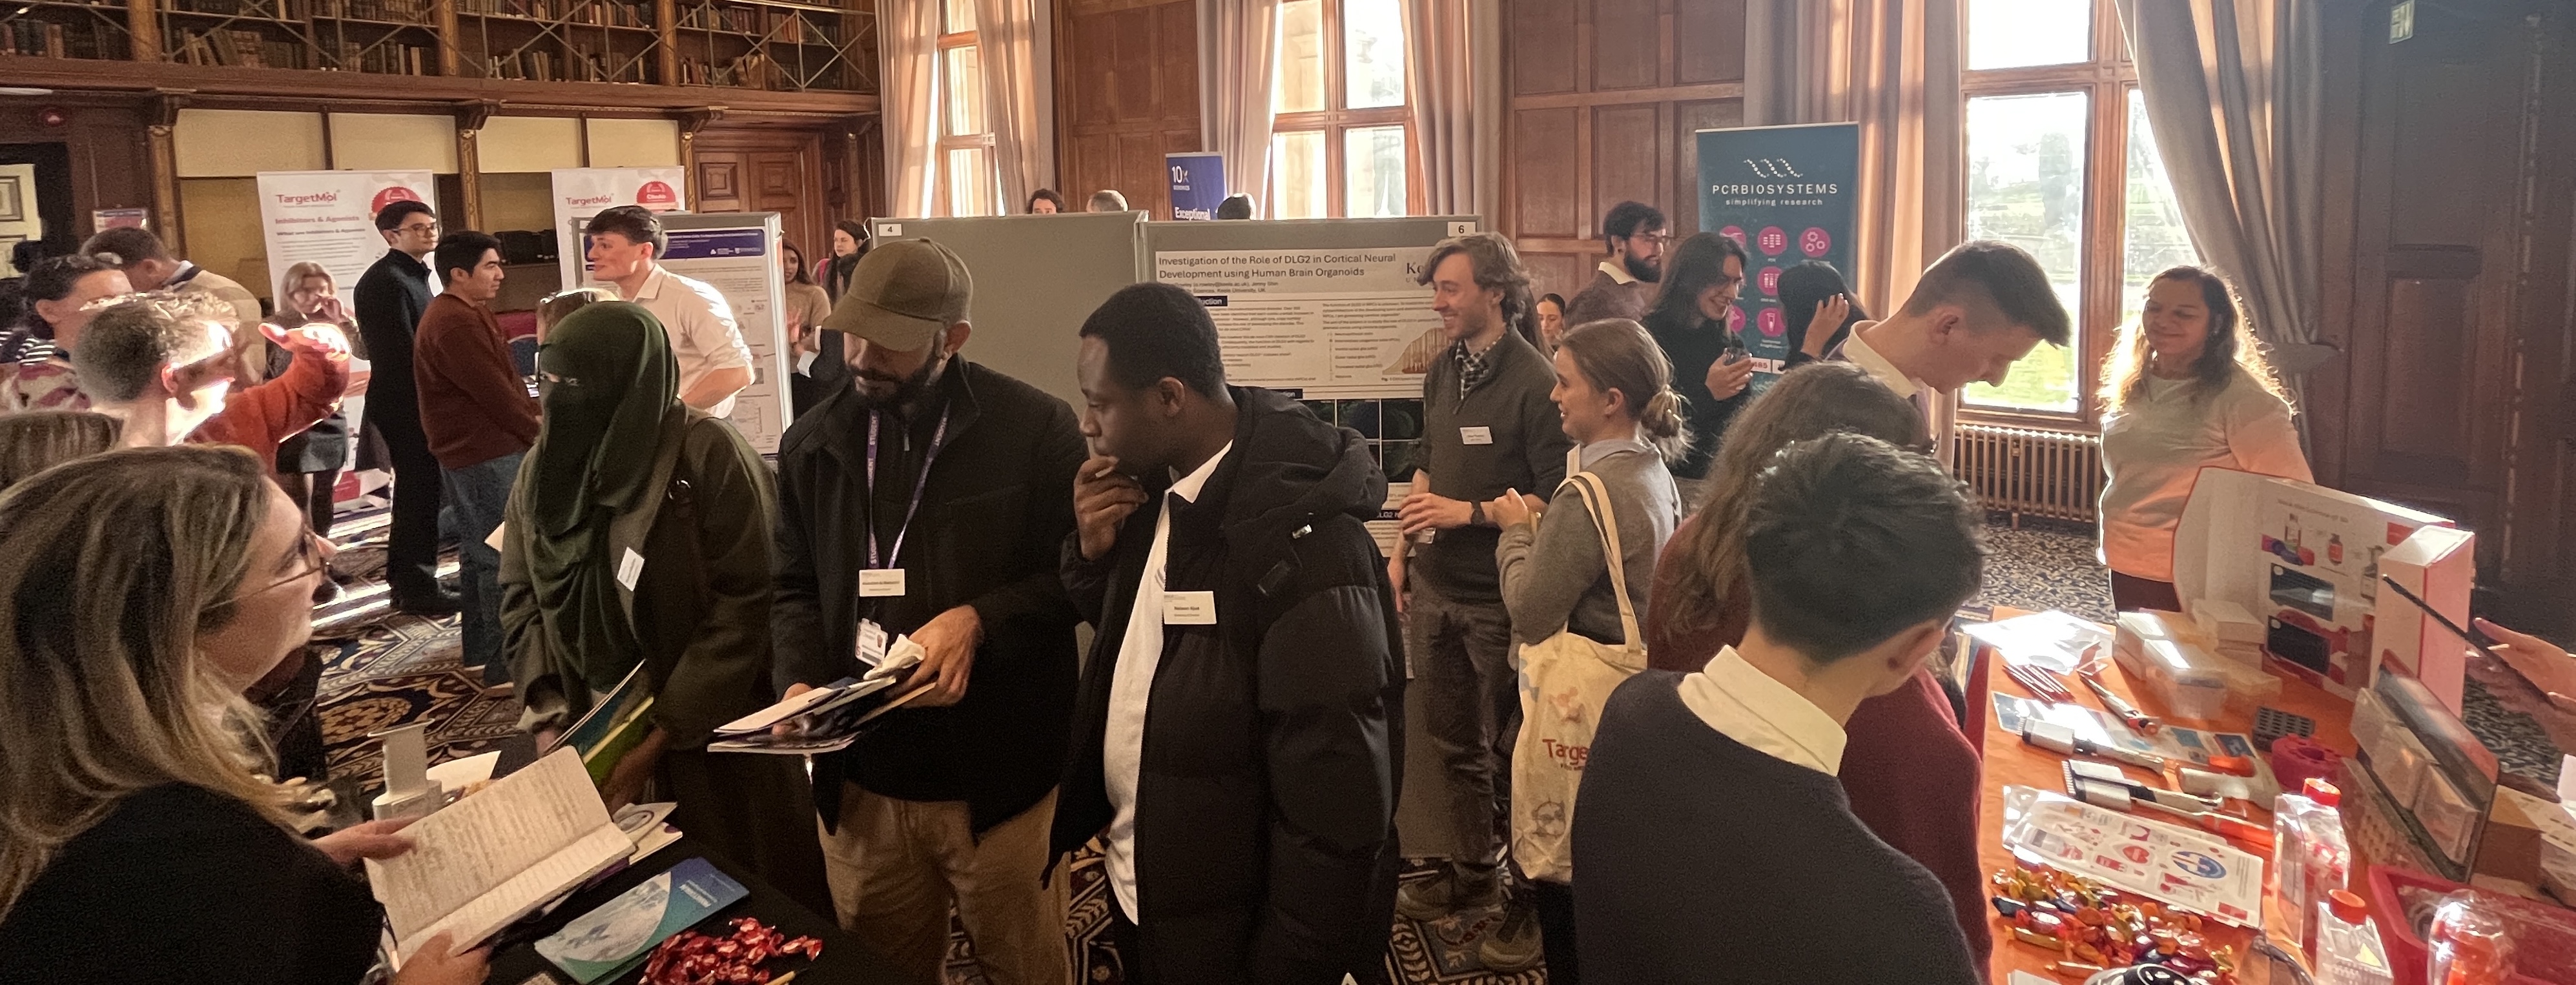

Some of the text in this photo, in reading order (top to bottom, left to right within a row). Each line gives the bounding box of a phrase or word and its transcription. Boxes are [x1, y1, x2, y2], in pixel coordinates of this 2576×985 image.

[1172, 166, 1189, 183] 10x
[1712, 184, 1837, 194] PCRBIOSYSTEMS
[276, 192, 337, 205] TargetMol
[566, 196, 612, 205] TargetMol
[1175, 207, 1211, 221] Exceptional
[1458, 225, 1465, 234] 6
[1159, 257, 1218, 267] Investigation
[1250, 256, 1270, 265] Role
[1273, 256, 1283, 264] of
[1313, 255, 1322, 263] in
[1324, 254, 1362, 263] Cortical
[1365, 254, 1396, 262] Neural
[1159, 267, 1365, 279] Development using Human Brain Organoids
[1542, 739, 1589, 765] Targe
